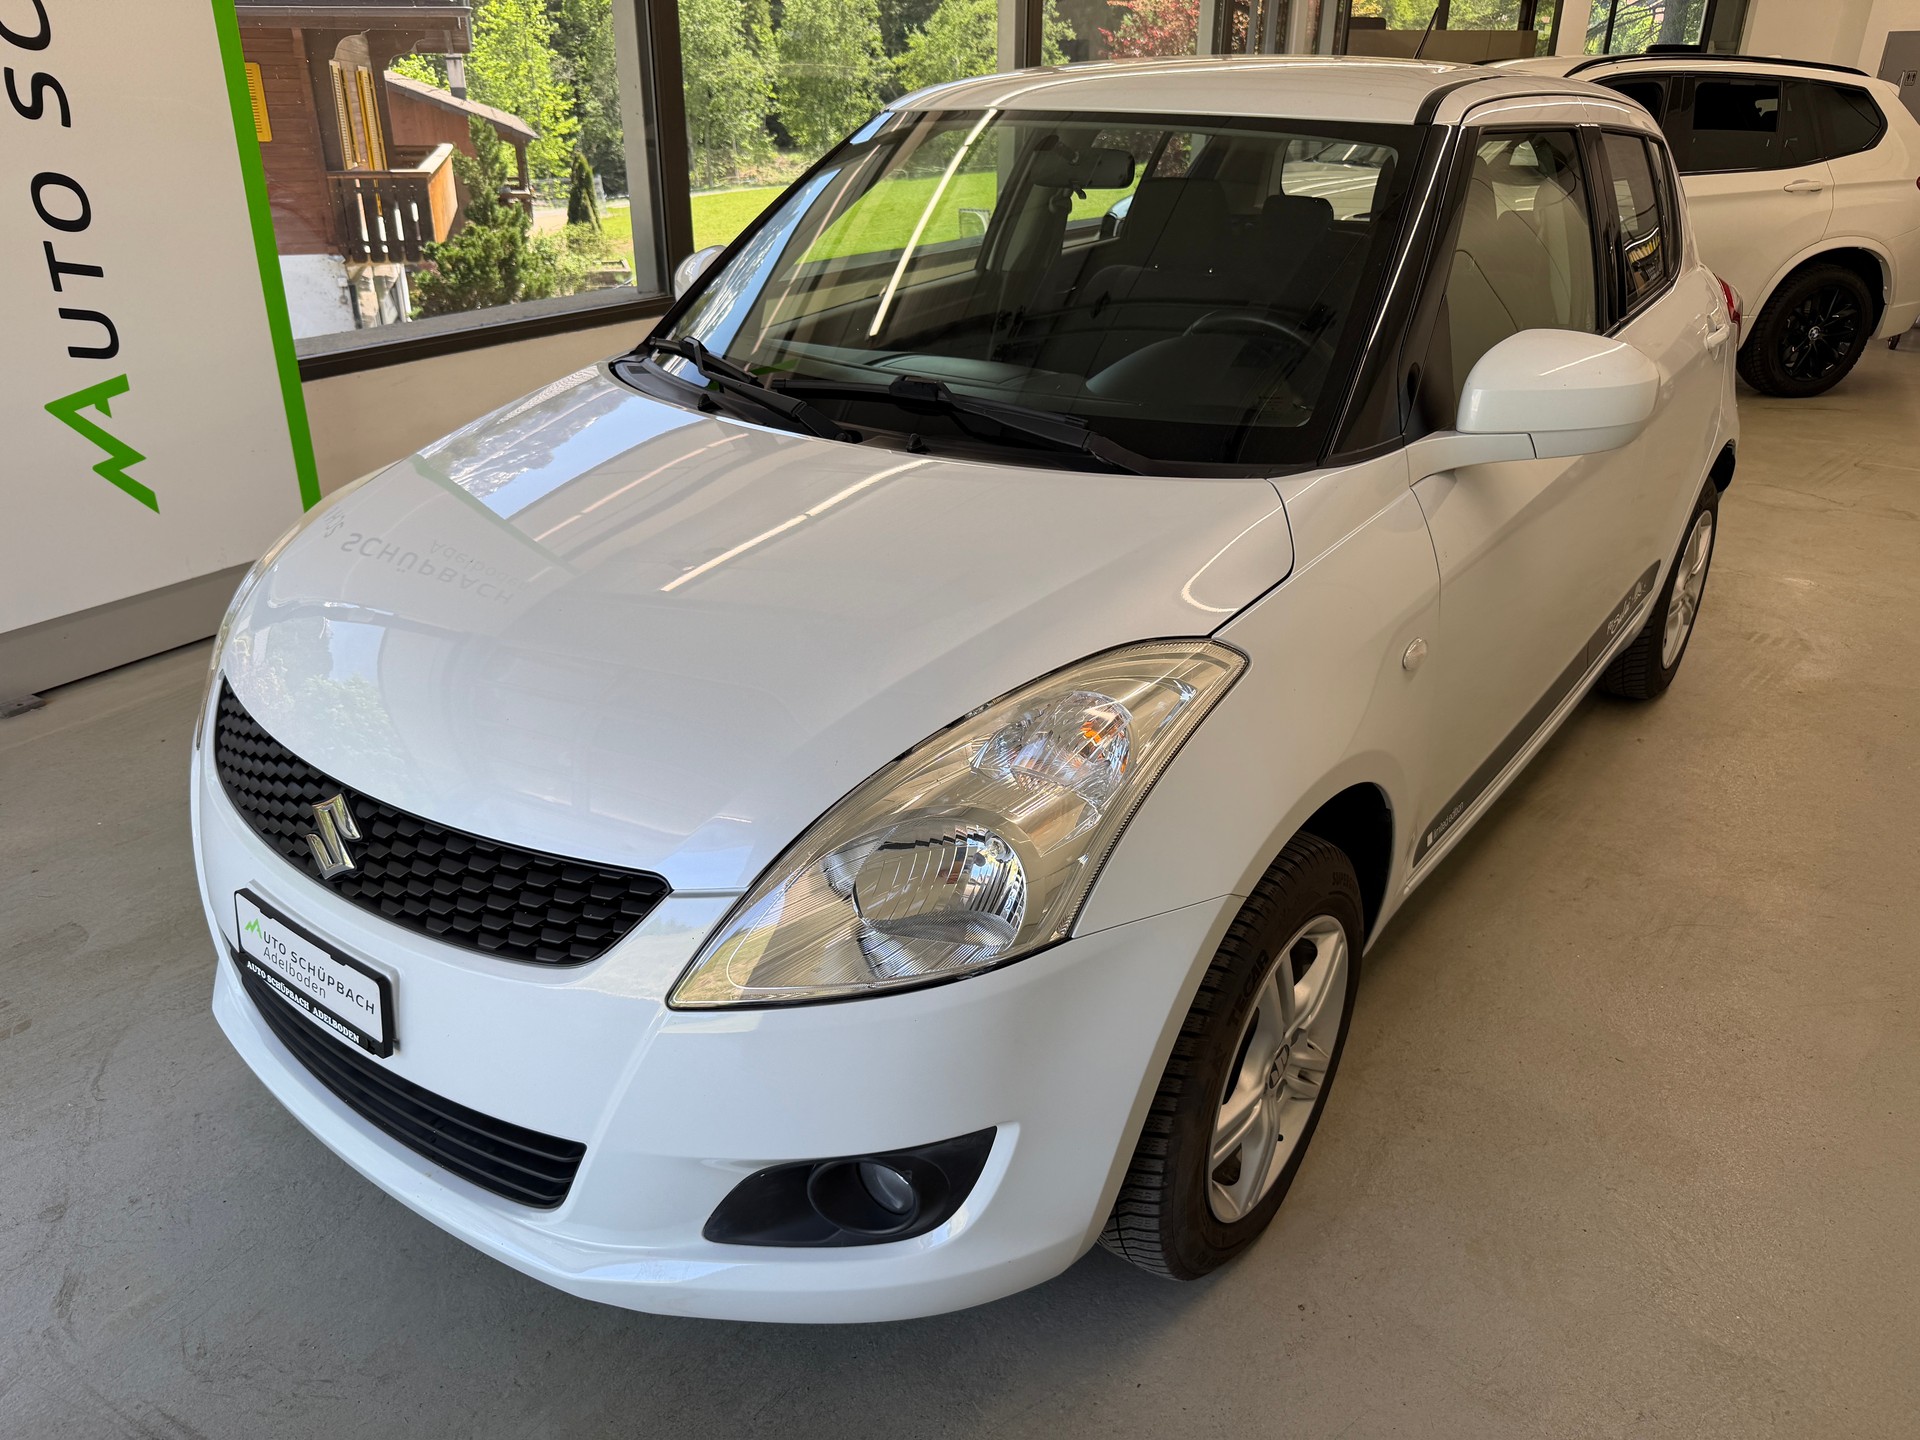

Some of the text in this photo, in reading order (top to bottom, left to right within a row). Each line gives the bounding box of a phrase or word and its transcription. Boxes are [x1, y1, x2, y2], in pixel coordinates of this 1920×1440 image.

[246, 960, 360, 1045] AUTO SCHÜPBACH ADELBODEN
[263, 946, 327, 999] Adelboden
[290, 950, 376, 1015] SCHÜPBACH
